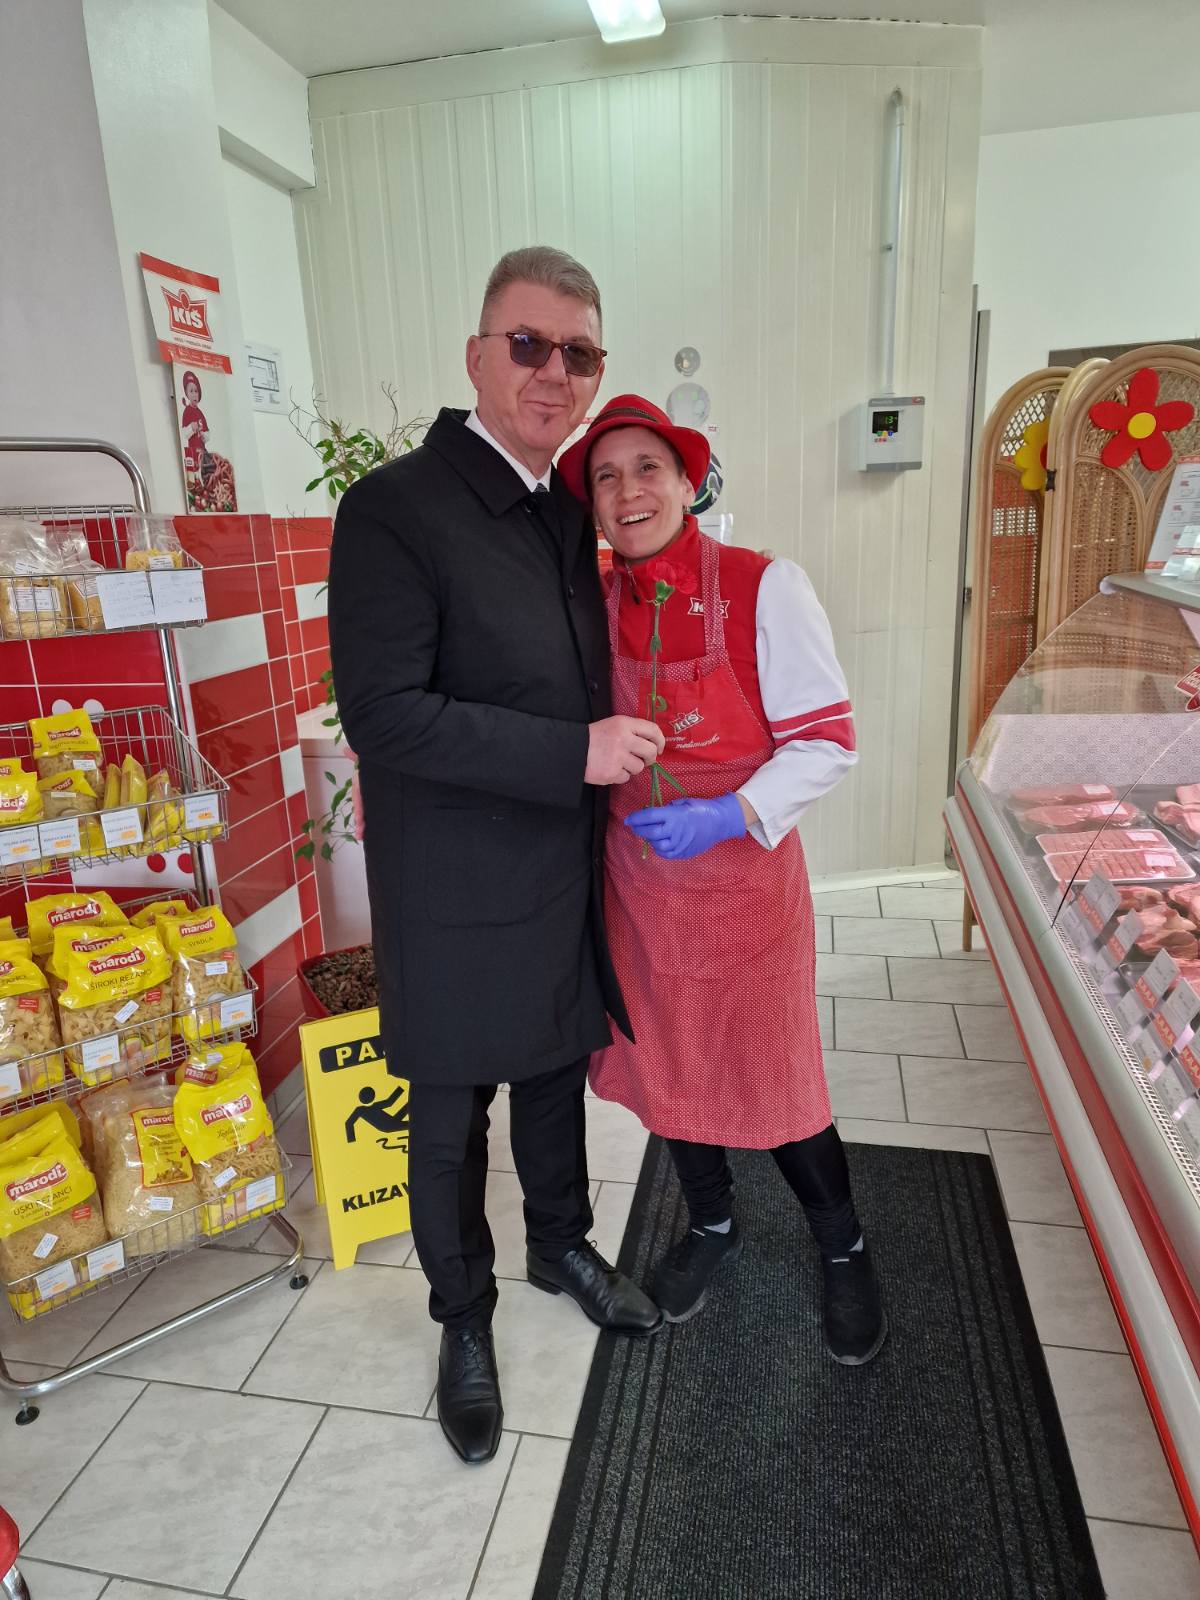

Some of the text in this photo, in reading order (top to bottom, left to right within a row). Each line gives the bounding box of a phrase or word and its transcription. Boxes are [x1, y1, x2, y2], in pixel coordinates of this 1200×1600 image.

[51, 903, 98, 922] marodi
[181, 919, 214, 935] marodi
[91, 950, 142, 971] marodi
[203, 1095, 248, 1123] madi
[143, 1114, 174, 1125] marod
[9, 1162, 66, 1198] marodi
